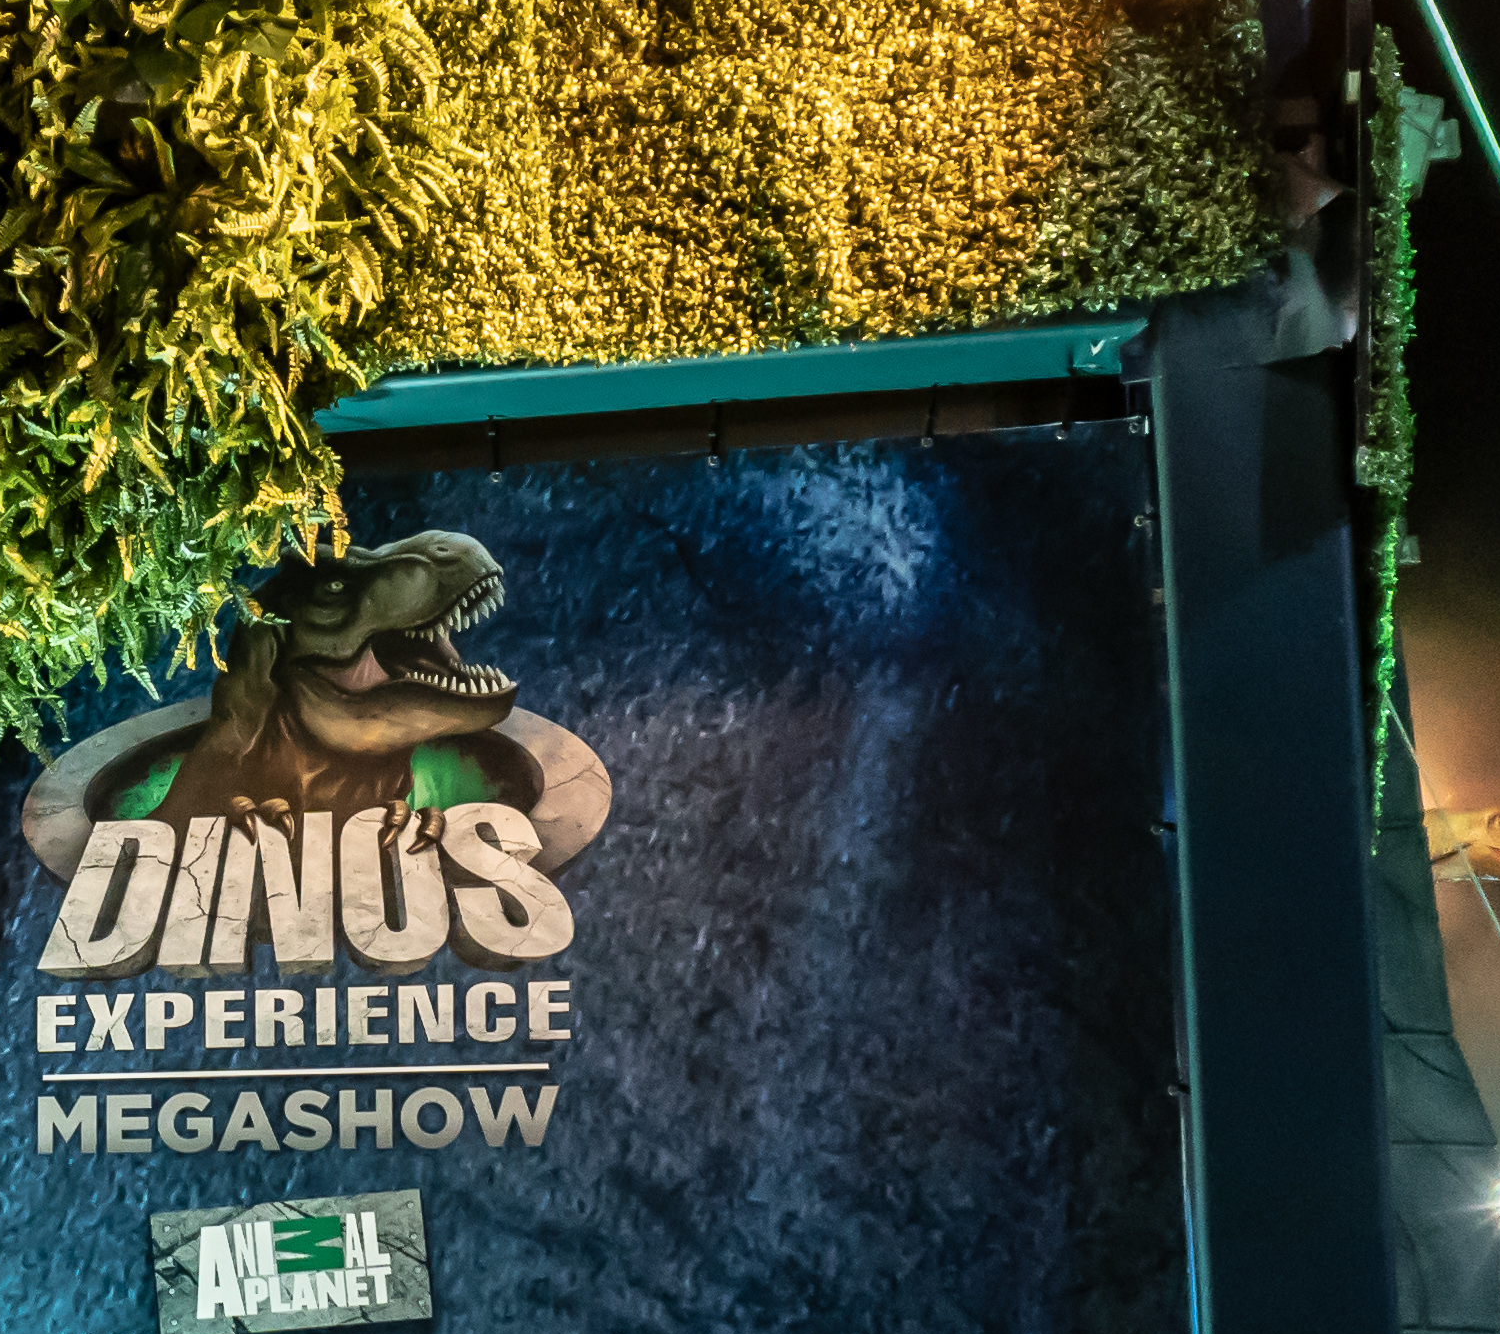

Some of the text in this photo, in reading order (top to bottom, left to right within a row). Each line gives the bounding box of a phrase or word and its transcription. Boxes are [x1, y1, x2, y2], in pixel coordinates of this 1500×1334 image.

[36, 801, 575, 979] DINOS
[36, 979, 573, 1053] EXPERIENCE
[36, 1084, 560, 1155] MEGASHOW
[244, 1264, 392, 1318] PLANET
